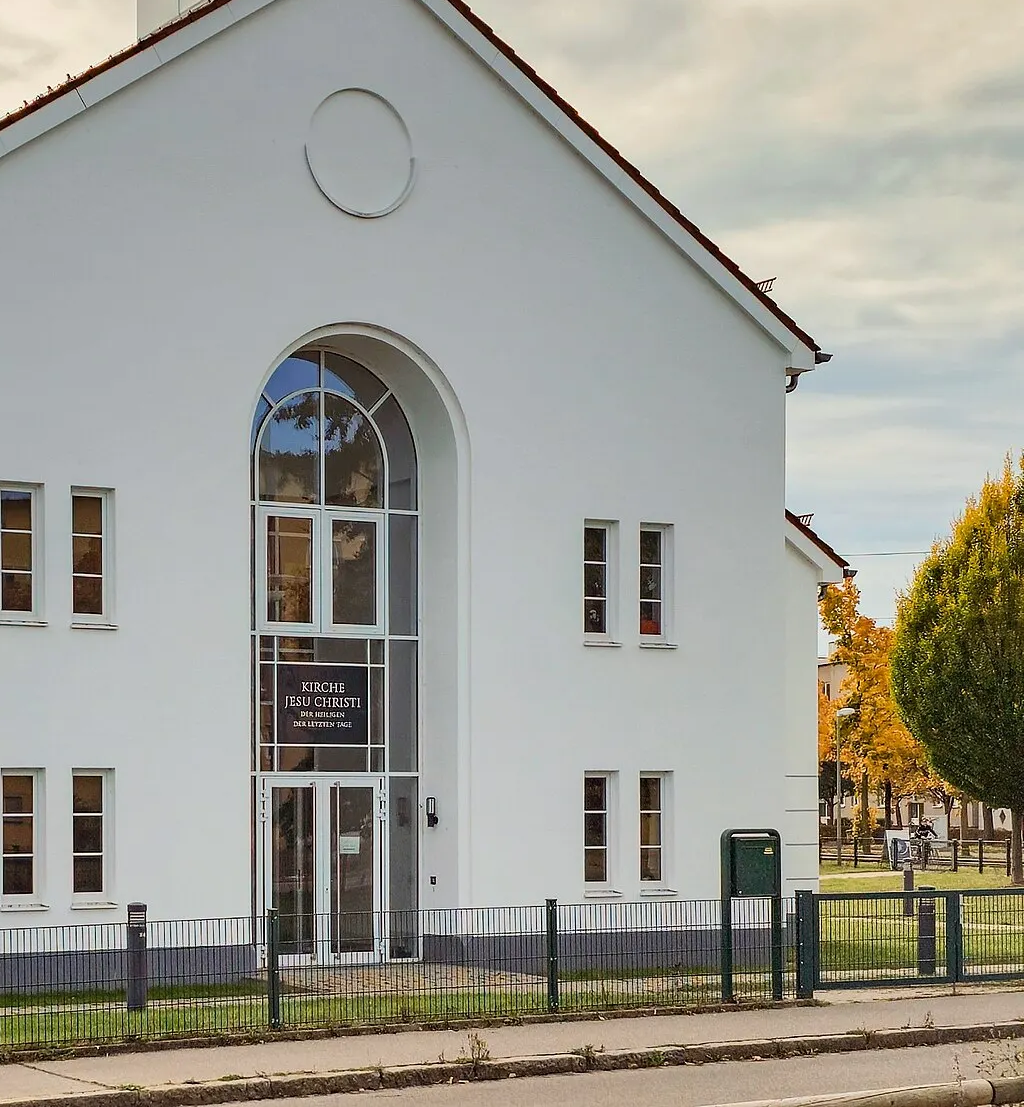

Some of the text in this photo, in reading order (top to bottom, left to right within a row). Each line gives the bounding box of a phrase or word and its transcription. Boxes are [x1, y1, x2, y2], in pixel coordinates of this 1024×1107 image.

[301, 681, 345, 693] KIRCHE
[284, 695, 361, 709] JESU CHRISTI
[300, 710, 314, 718] DER
[293, 720, 307, 728] DER
